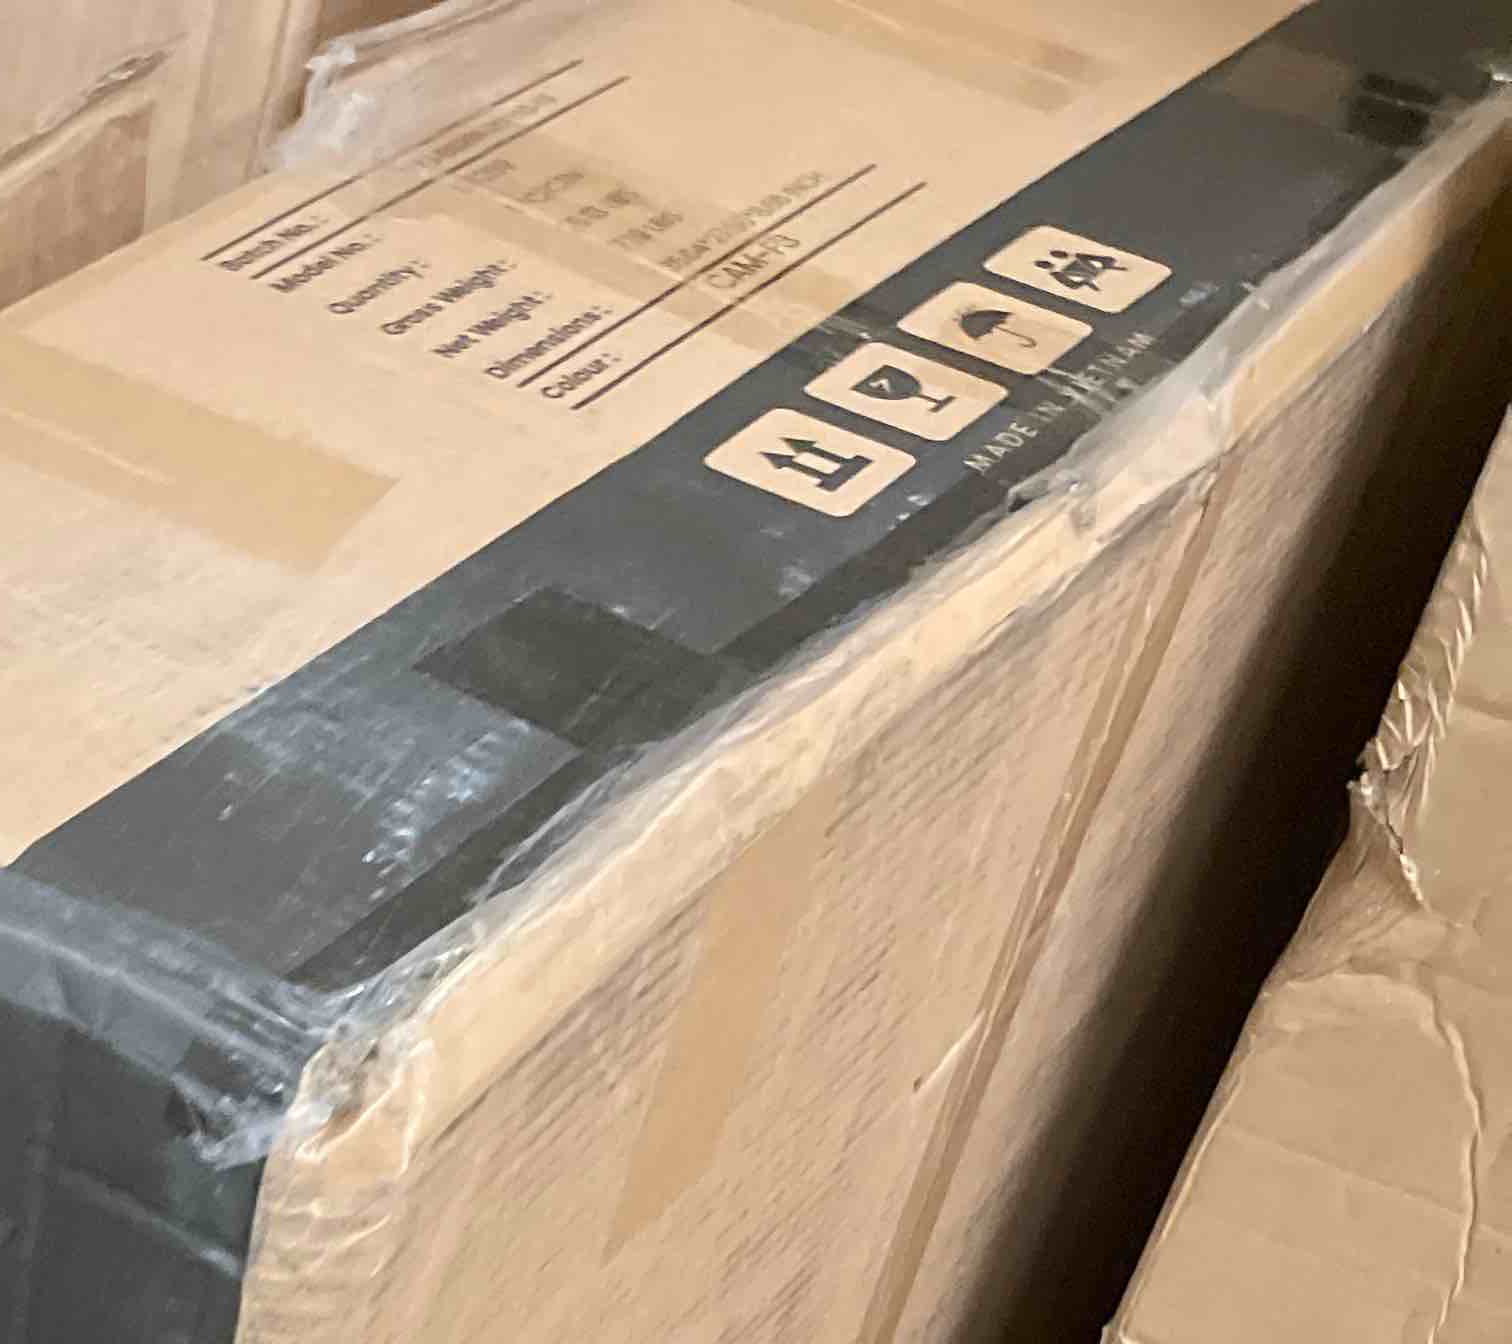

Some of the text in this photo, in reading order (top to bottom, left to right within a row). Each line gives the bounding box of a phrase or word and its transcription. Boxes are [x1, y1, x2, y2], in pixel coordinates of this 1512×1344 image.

[219, 239, 284, 272] Batch
[268, 255, 338, 293] Model
[381, 302, 444, 336] Gross
[431, 334, 481, 359] Net
[962, 421, 1039, 476] MADE
[1062, 331, 1156, 405] ETNAM
